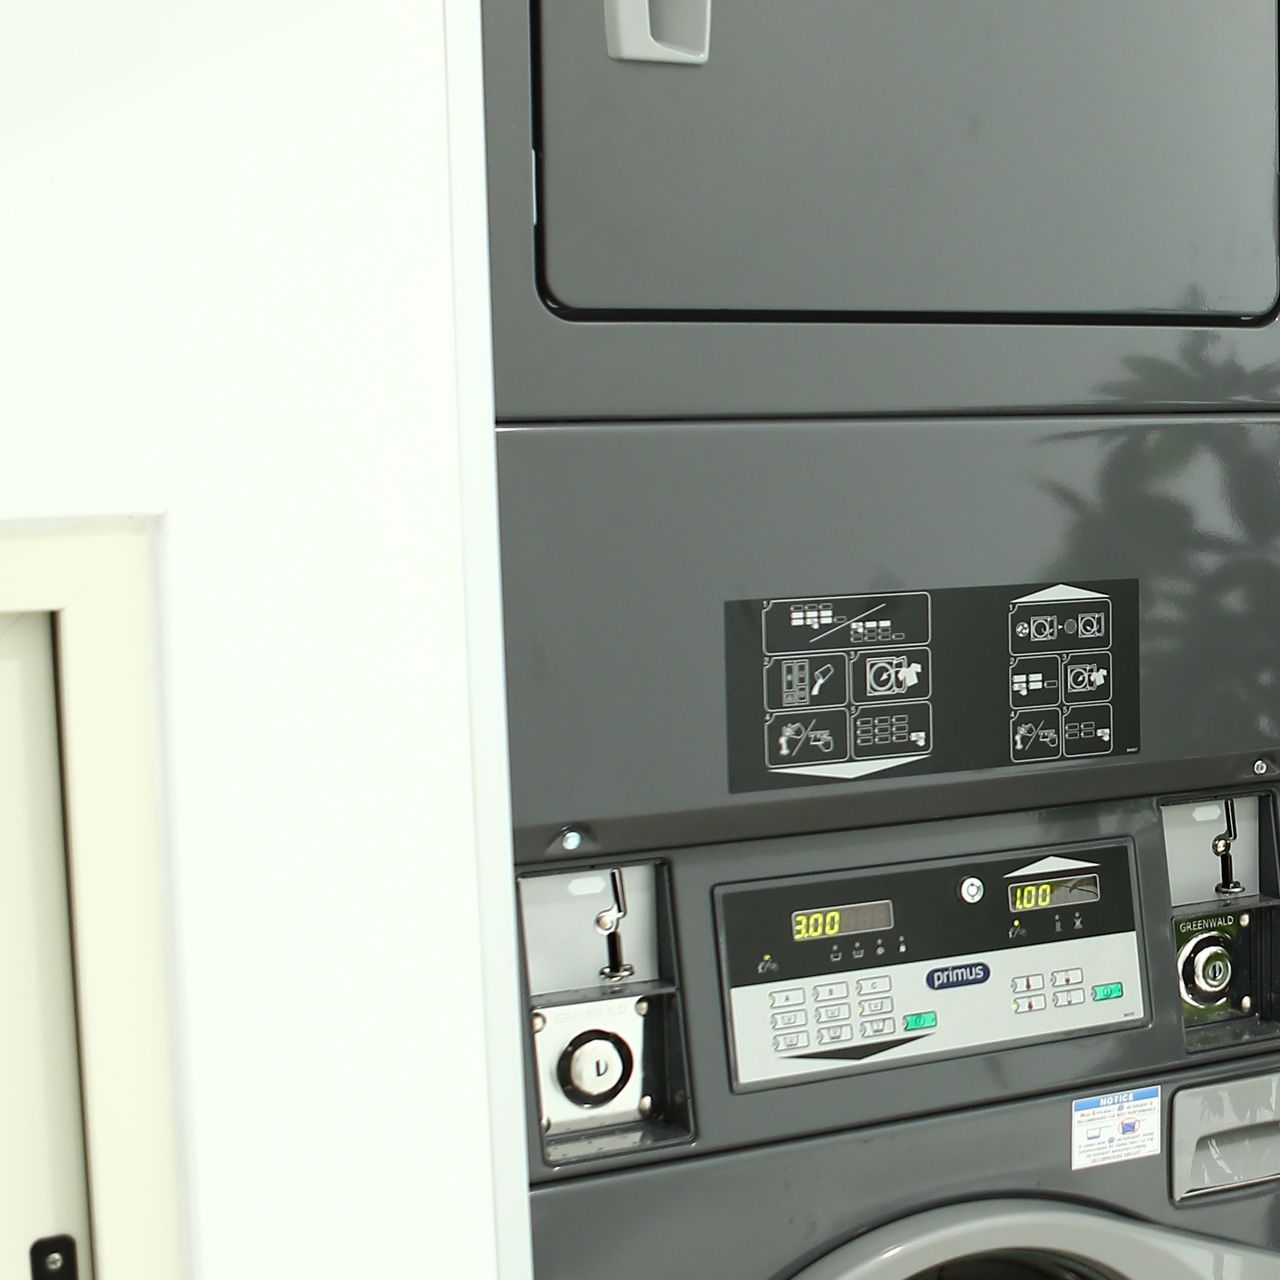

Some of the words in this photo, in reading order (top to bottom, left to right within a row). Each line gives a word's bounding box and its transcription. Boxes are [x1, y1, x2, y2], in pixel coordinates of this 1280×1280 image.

[1014, 883, 1051, 910] 1.00
[793, 911, 840, 942] 3.00
[1179, 915, 1234, 933] GREENWALD
[933, 964, 985, 988] primus
[1100, 1092, 1134, 1105] NOTICE
